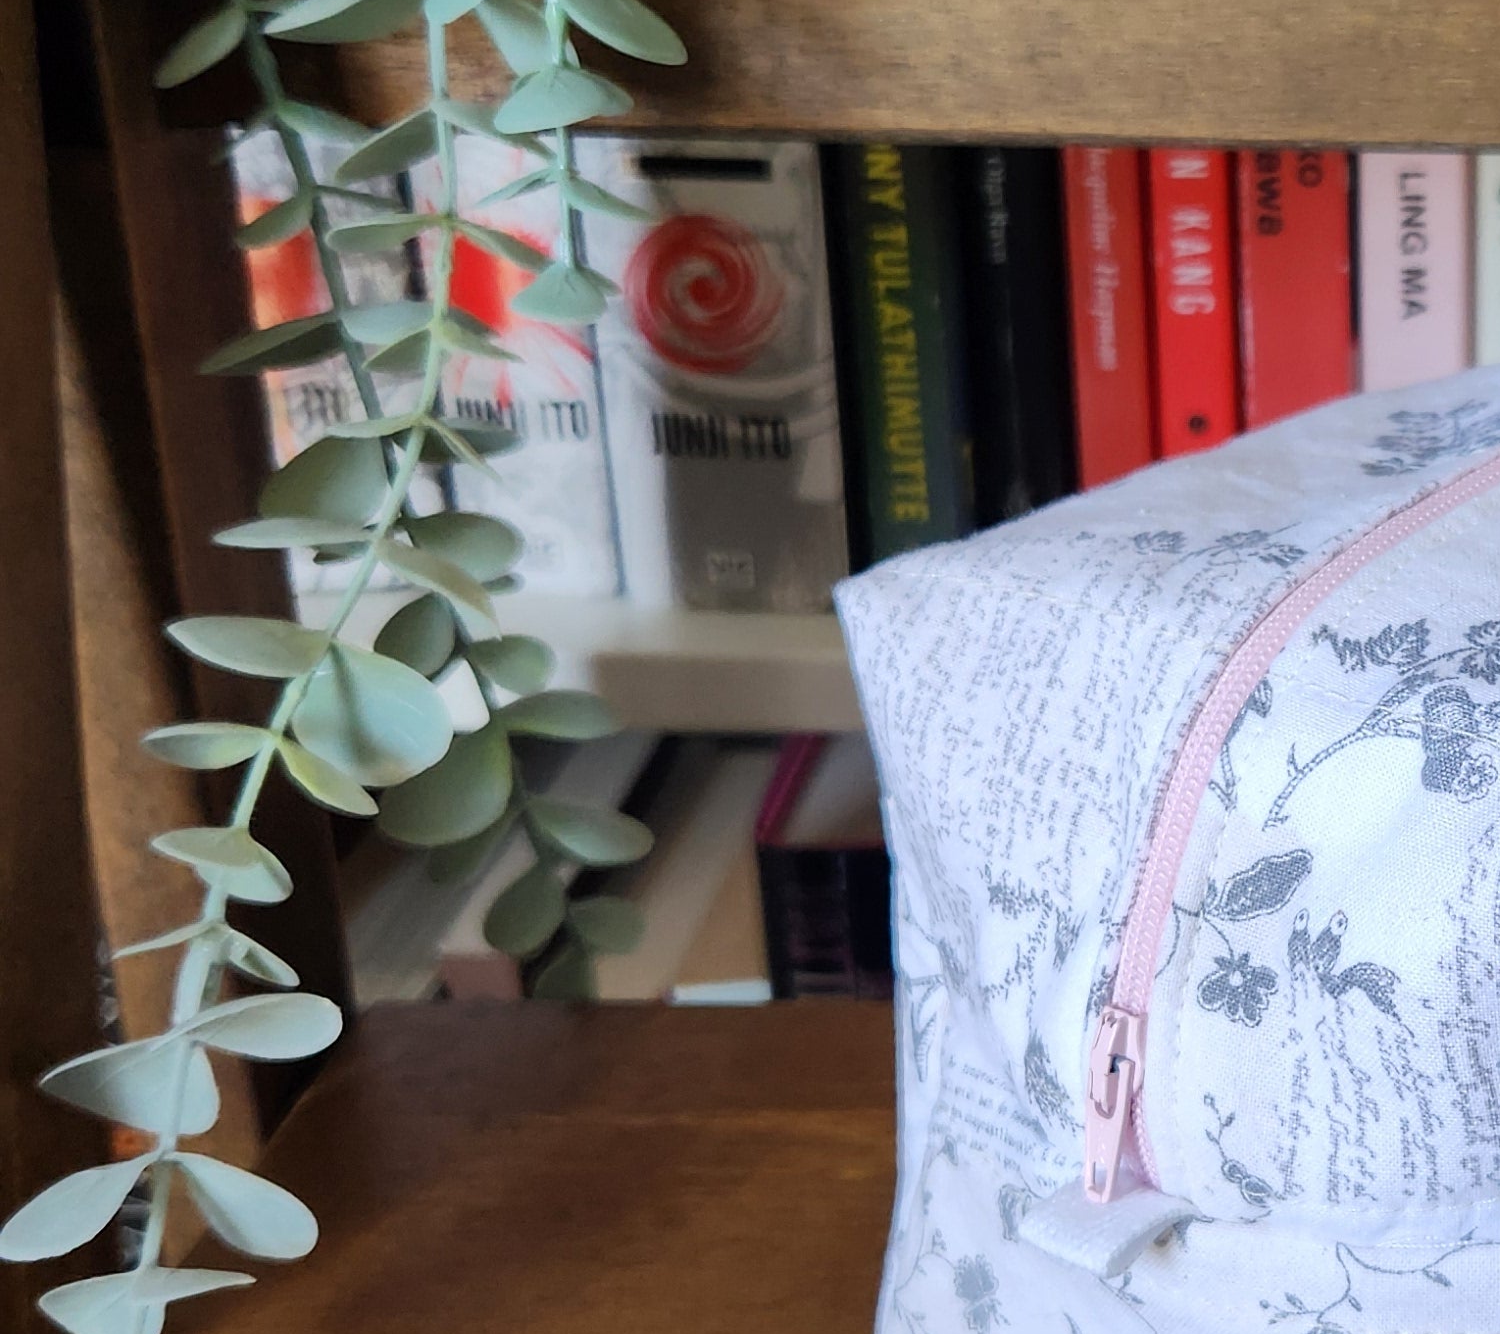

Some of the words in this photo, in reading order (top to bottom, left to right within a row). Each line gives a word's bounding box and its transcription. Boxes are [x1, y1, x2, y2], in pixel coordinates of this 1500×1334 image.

[1399, 168, 1429, 257] LING
[1169, 205, 1216, 316] KANG
[1400, 271, 1429, 321] MA
[869, 225, 930, 523] TULATHIMUTTE
[540, 398, 589, 442] ITO
[737, 415, 793, 459] ITO
